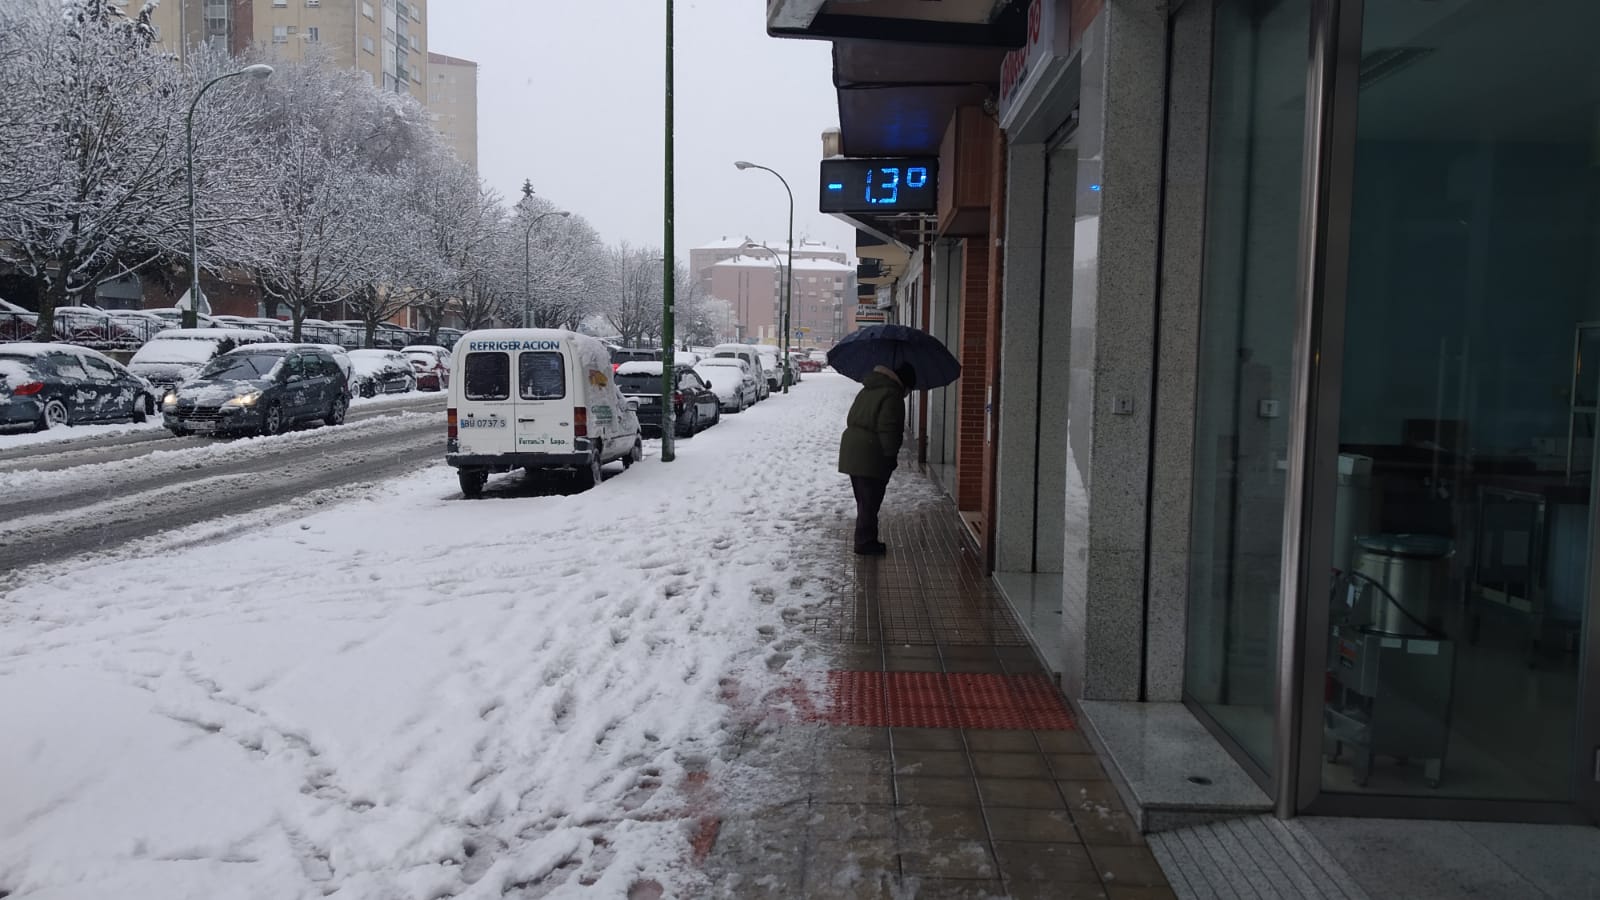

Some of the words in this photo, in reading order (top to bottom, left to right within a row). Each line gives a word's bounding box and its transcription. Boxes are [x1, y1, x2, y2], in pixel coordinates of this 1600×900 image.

[469, 340, 560, 351] REFRIGERACION
[464, 419, 475, 428] BU
[476, 419, 497, 428] 0737
